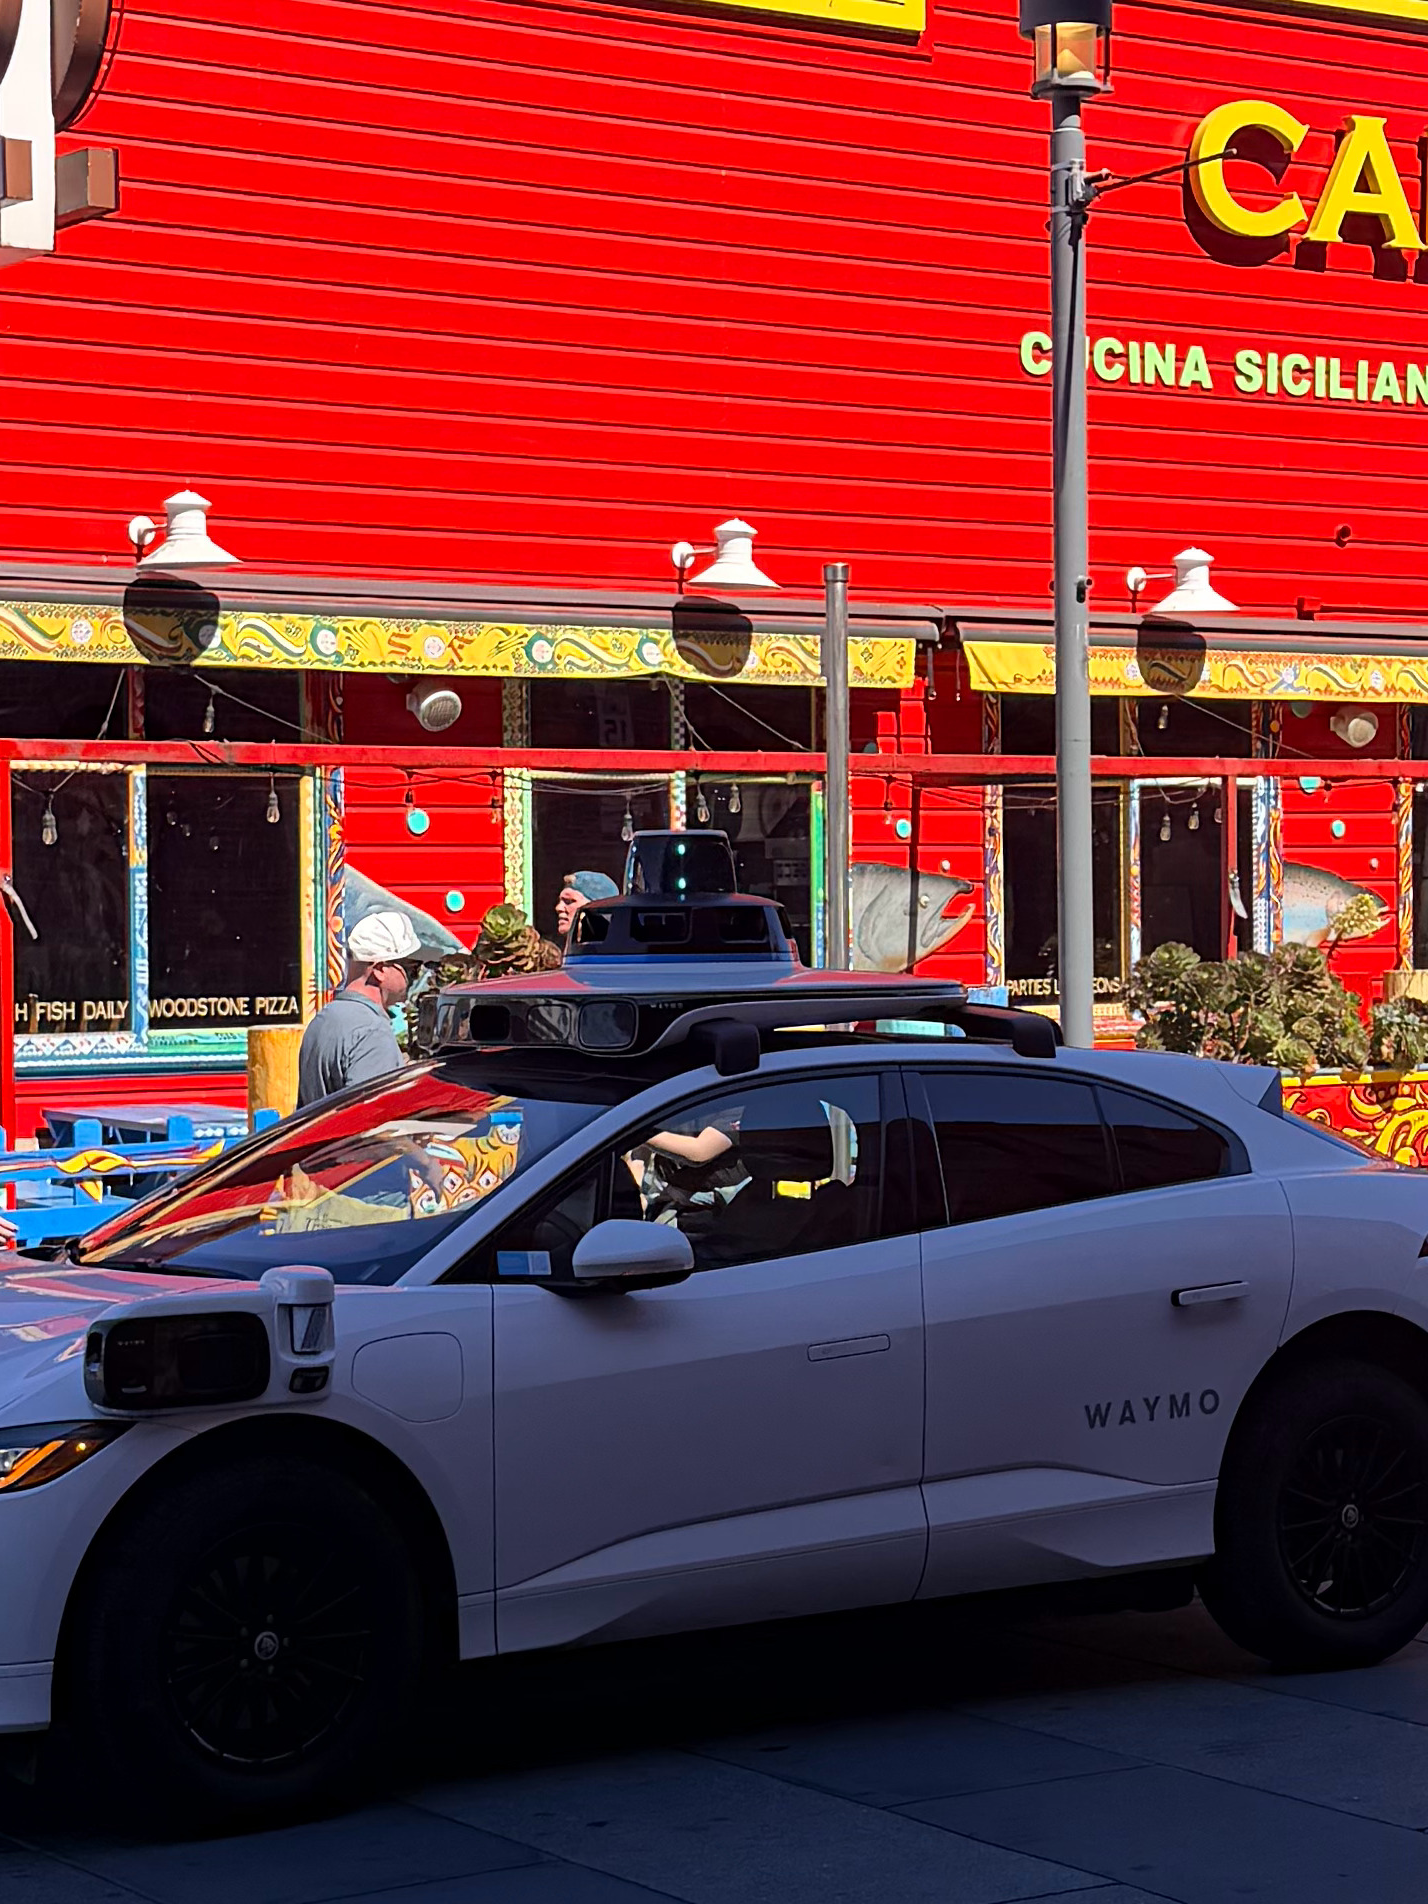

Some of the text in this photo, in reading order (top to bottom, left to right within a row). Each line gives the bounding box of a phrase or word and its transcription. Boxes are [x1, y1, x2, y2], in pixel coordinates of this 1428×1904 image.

[1021, 331, 1212, 389] CCINA
[1006, 976, 1120, 996] PARTIES LEONS
[36, 1001, 76, 1021] FISH
[83, 999, 129, 1020] DAILY
[149, 996, 299, 1018] WOODSTONE PIZZA
[1084, 1388, 1220, 1430] WAYMO
